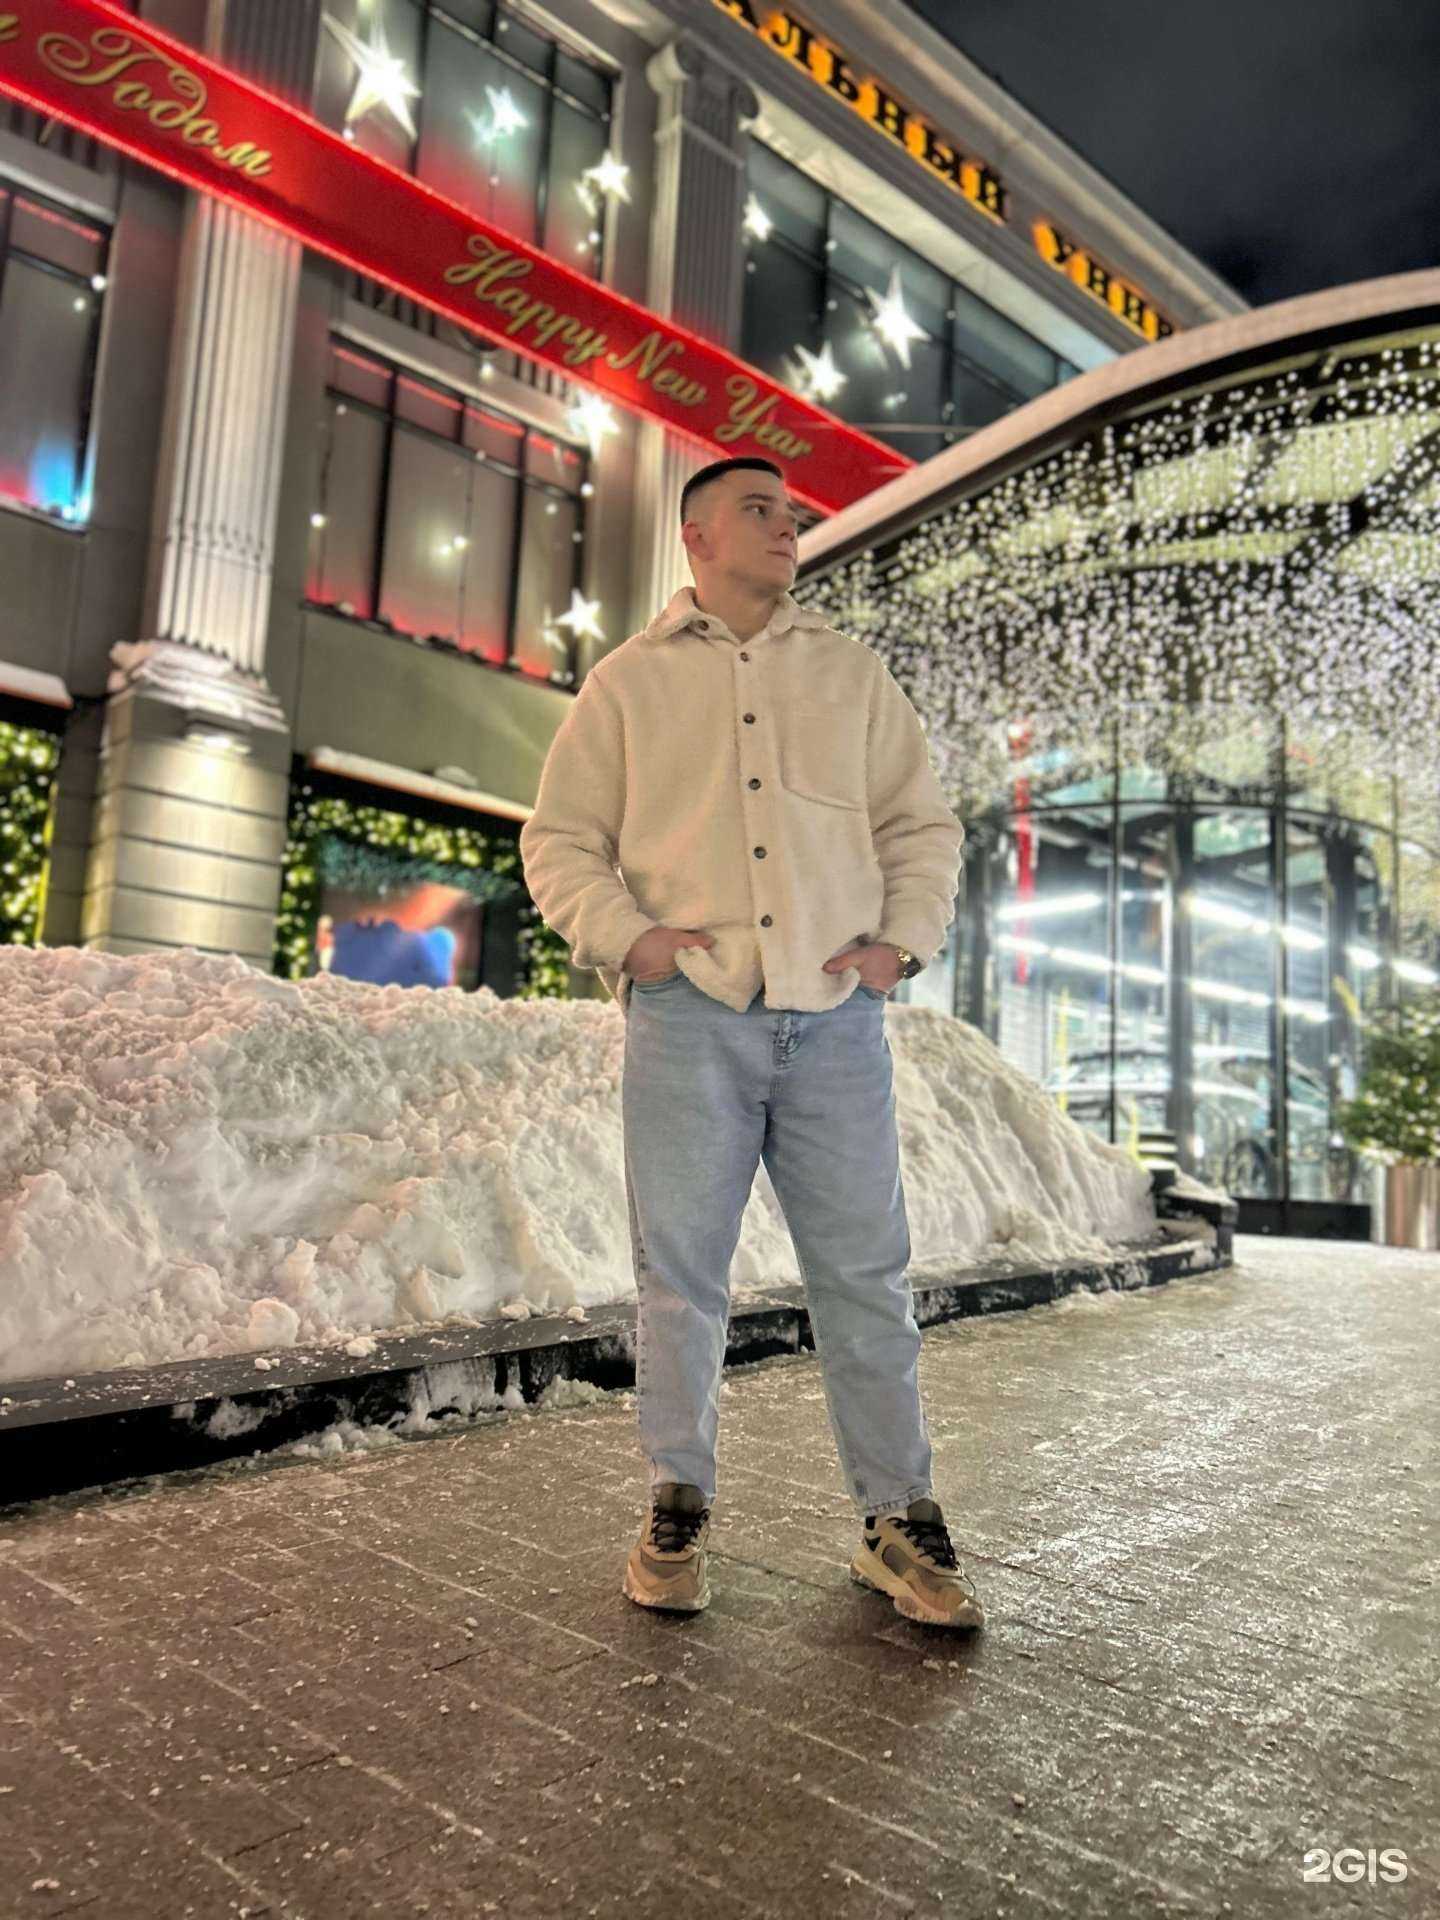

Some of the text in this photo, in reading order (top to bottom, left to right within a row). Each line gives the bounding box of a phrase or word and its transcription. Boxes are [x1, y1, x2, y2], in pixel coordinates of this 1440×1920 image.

[38, 28, 272, 178] Годом
[444, 234, 813, 460] Happy New Year
